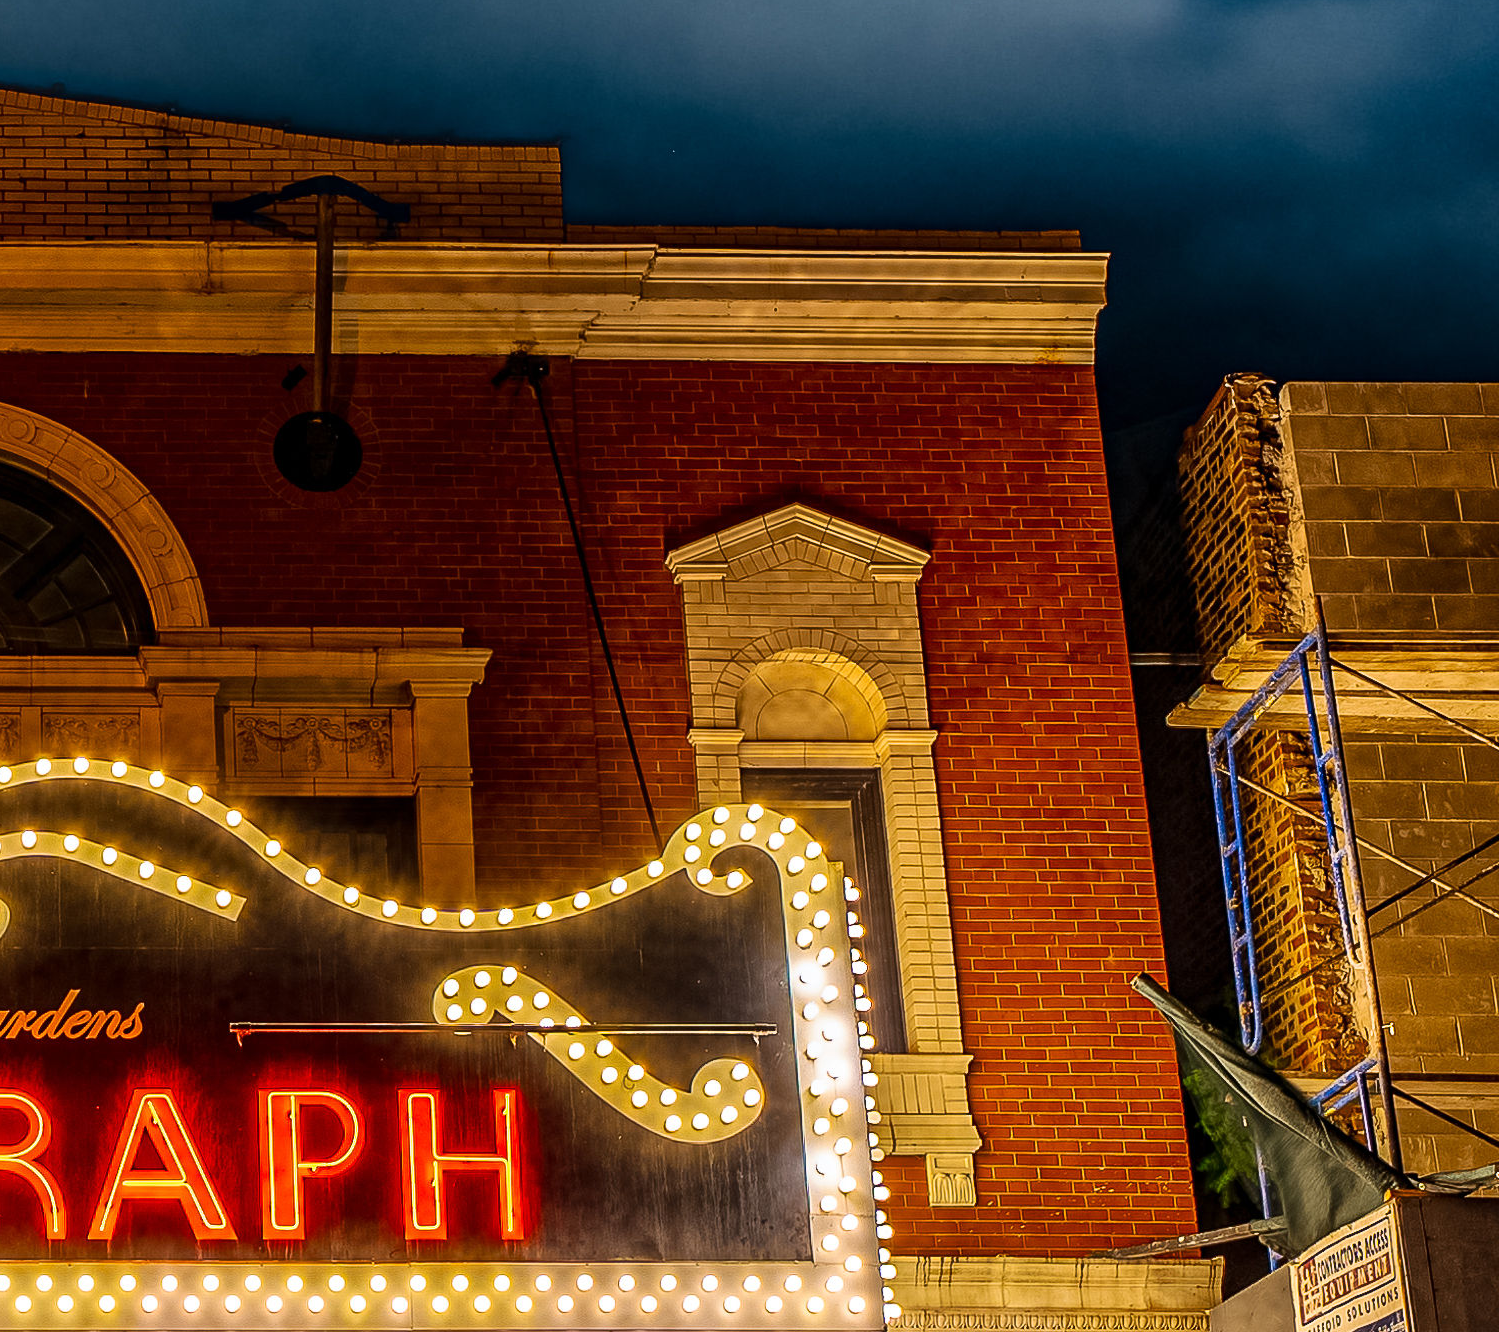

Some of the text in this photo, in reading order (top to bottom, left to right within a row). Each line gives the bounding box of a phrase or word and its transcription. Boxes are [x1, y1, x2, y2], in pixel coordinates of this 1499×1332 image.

[1317, 1228, 1389, 1282] CONTRACTORS ACCESS
[1323, 1254, 1391, 1305] EQUIPMENT
[1347, 1286, 1399, 1323] SOLUTIONS
